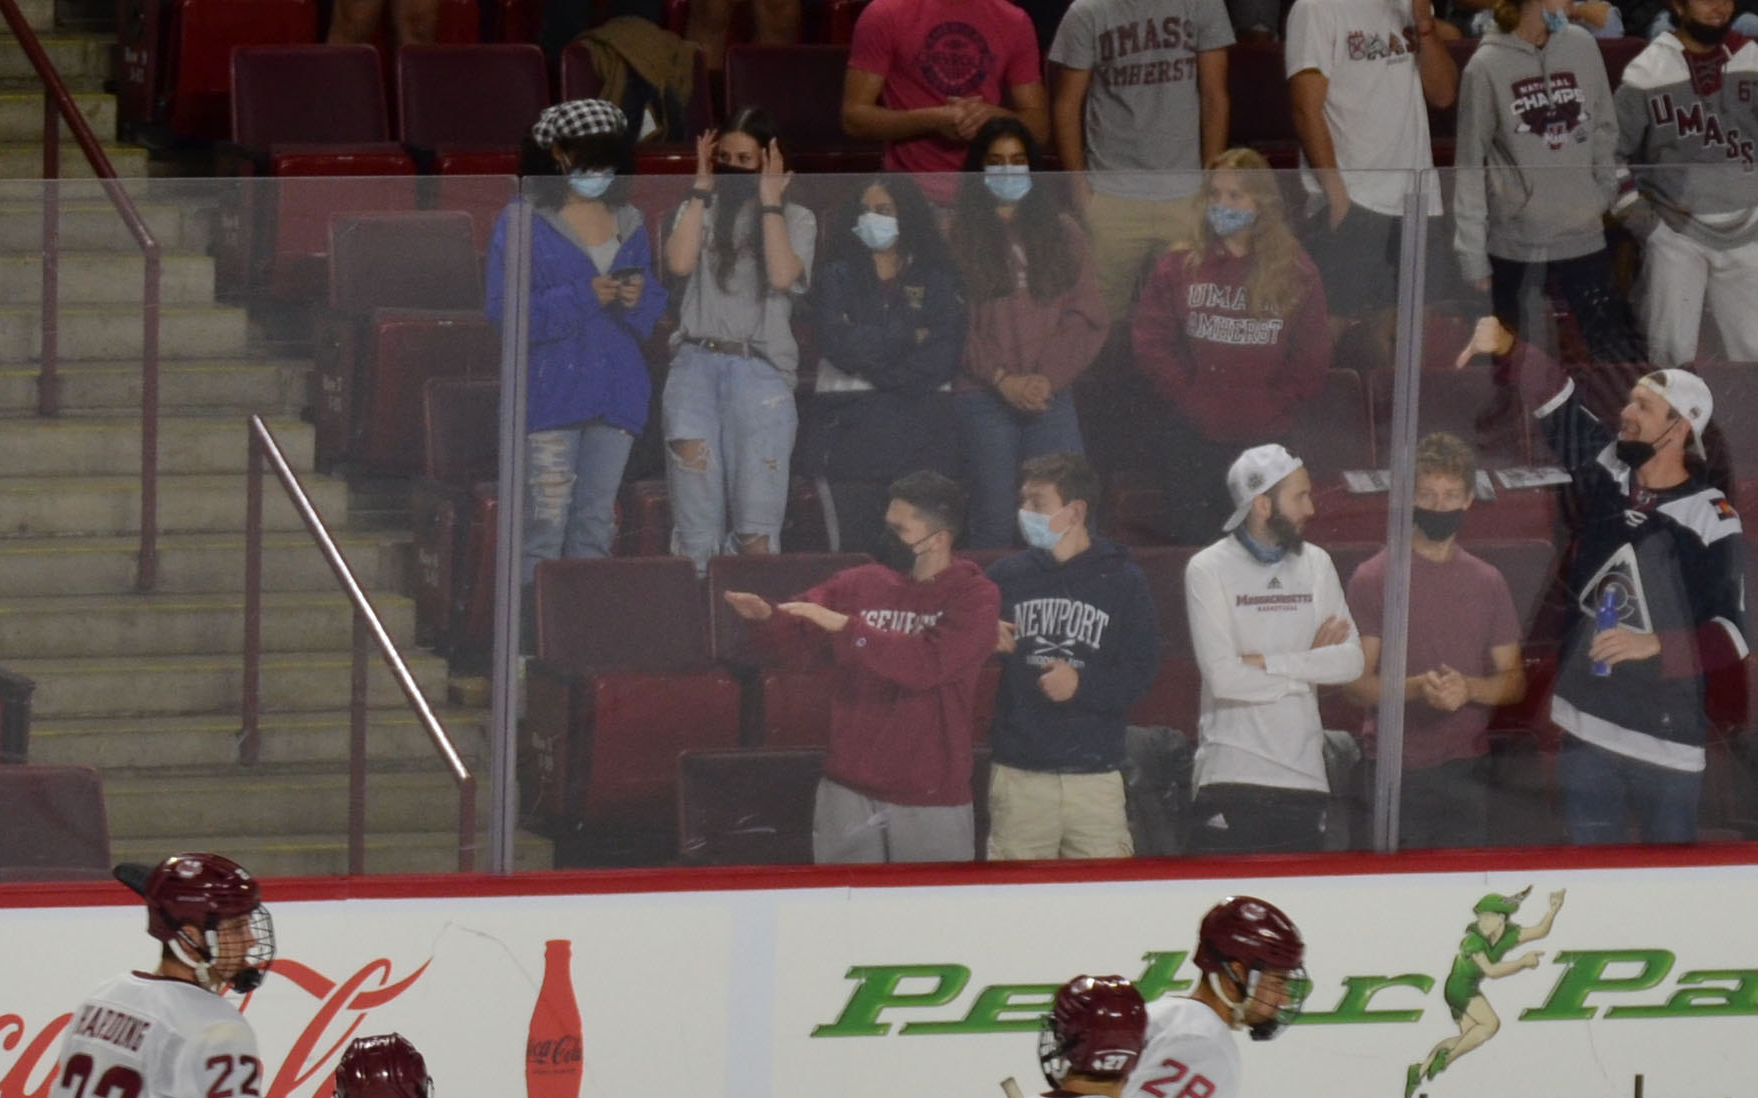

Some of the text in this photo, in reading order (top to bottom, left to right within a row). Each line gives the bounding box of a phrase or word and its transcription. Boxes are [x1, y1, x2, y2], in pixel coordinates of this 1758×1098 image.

[1650, 93, 1755, 174] UMASS
[1186, 312, 1284, 345] AMHERST
[1013, 598, 1110, 650] NEWPORT
[810, 948, 1438, 1038] Petr
[1103, 1055, 1129, 1071] 27
